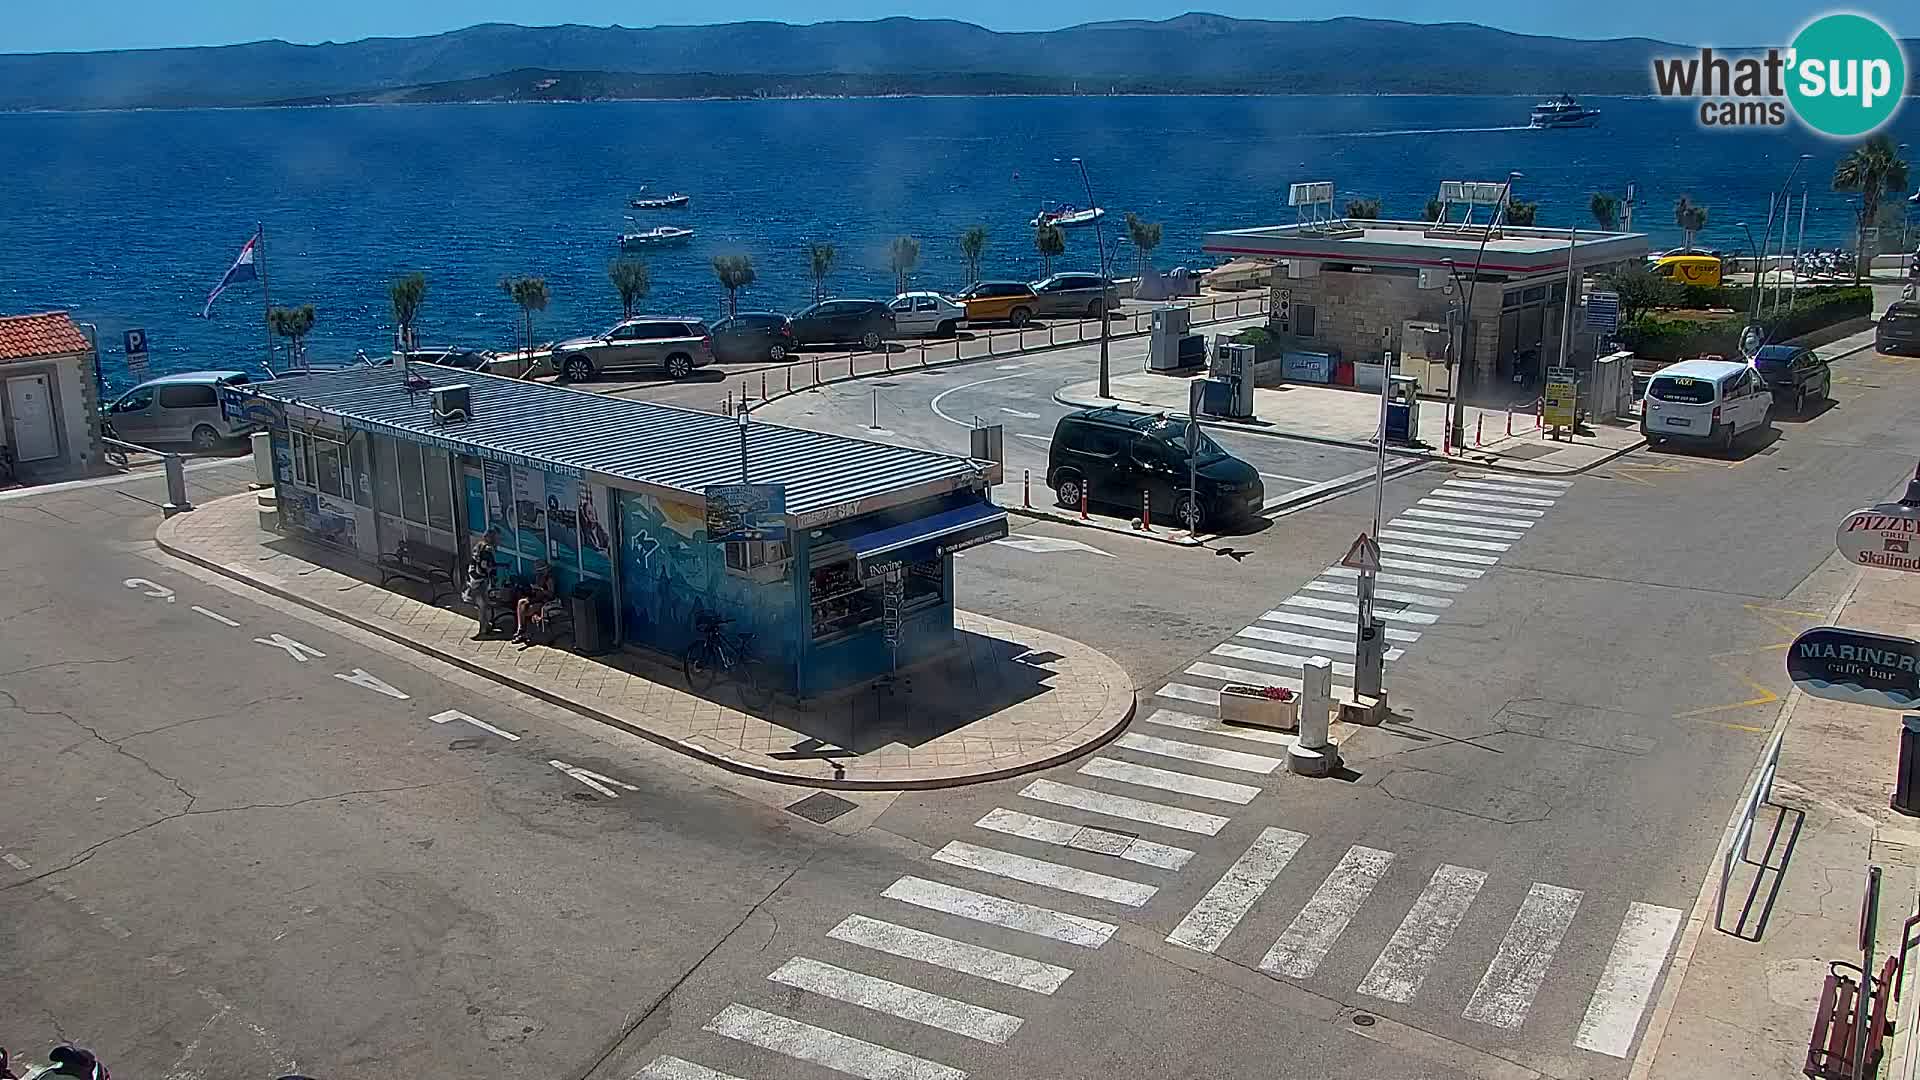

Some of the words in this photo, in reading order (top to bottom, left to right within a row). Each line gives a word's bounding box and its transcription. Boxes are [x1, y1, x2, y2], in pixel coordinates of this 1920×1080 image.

[128, 332, 142, 350] P
[1674, 377, 1693, 386] TAXI
[435, 438, 467, 453] POSTAJA
[477, 447, 492, 458] BUS
[493, 450, 525, 466] STATION
[527, 457, 553, 473] TICKET
[554, 463, 581, 478] OFFICE
[1847, 516, 1920, 535] PIZZE
[1869, 667, 1897, 680] bar
